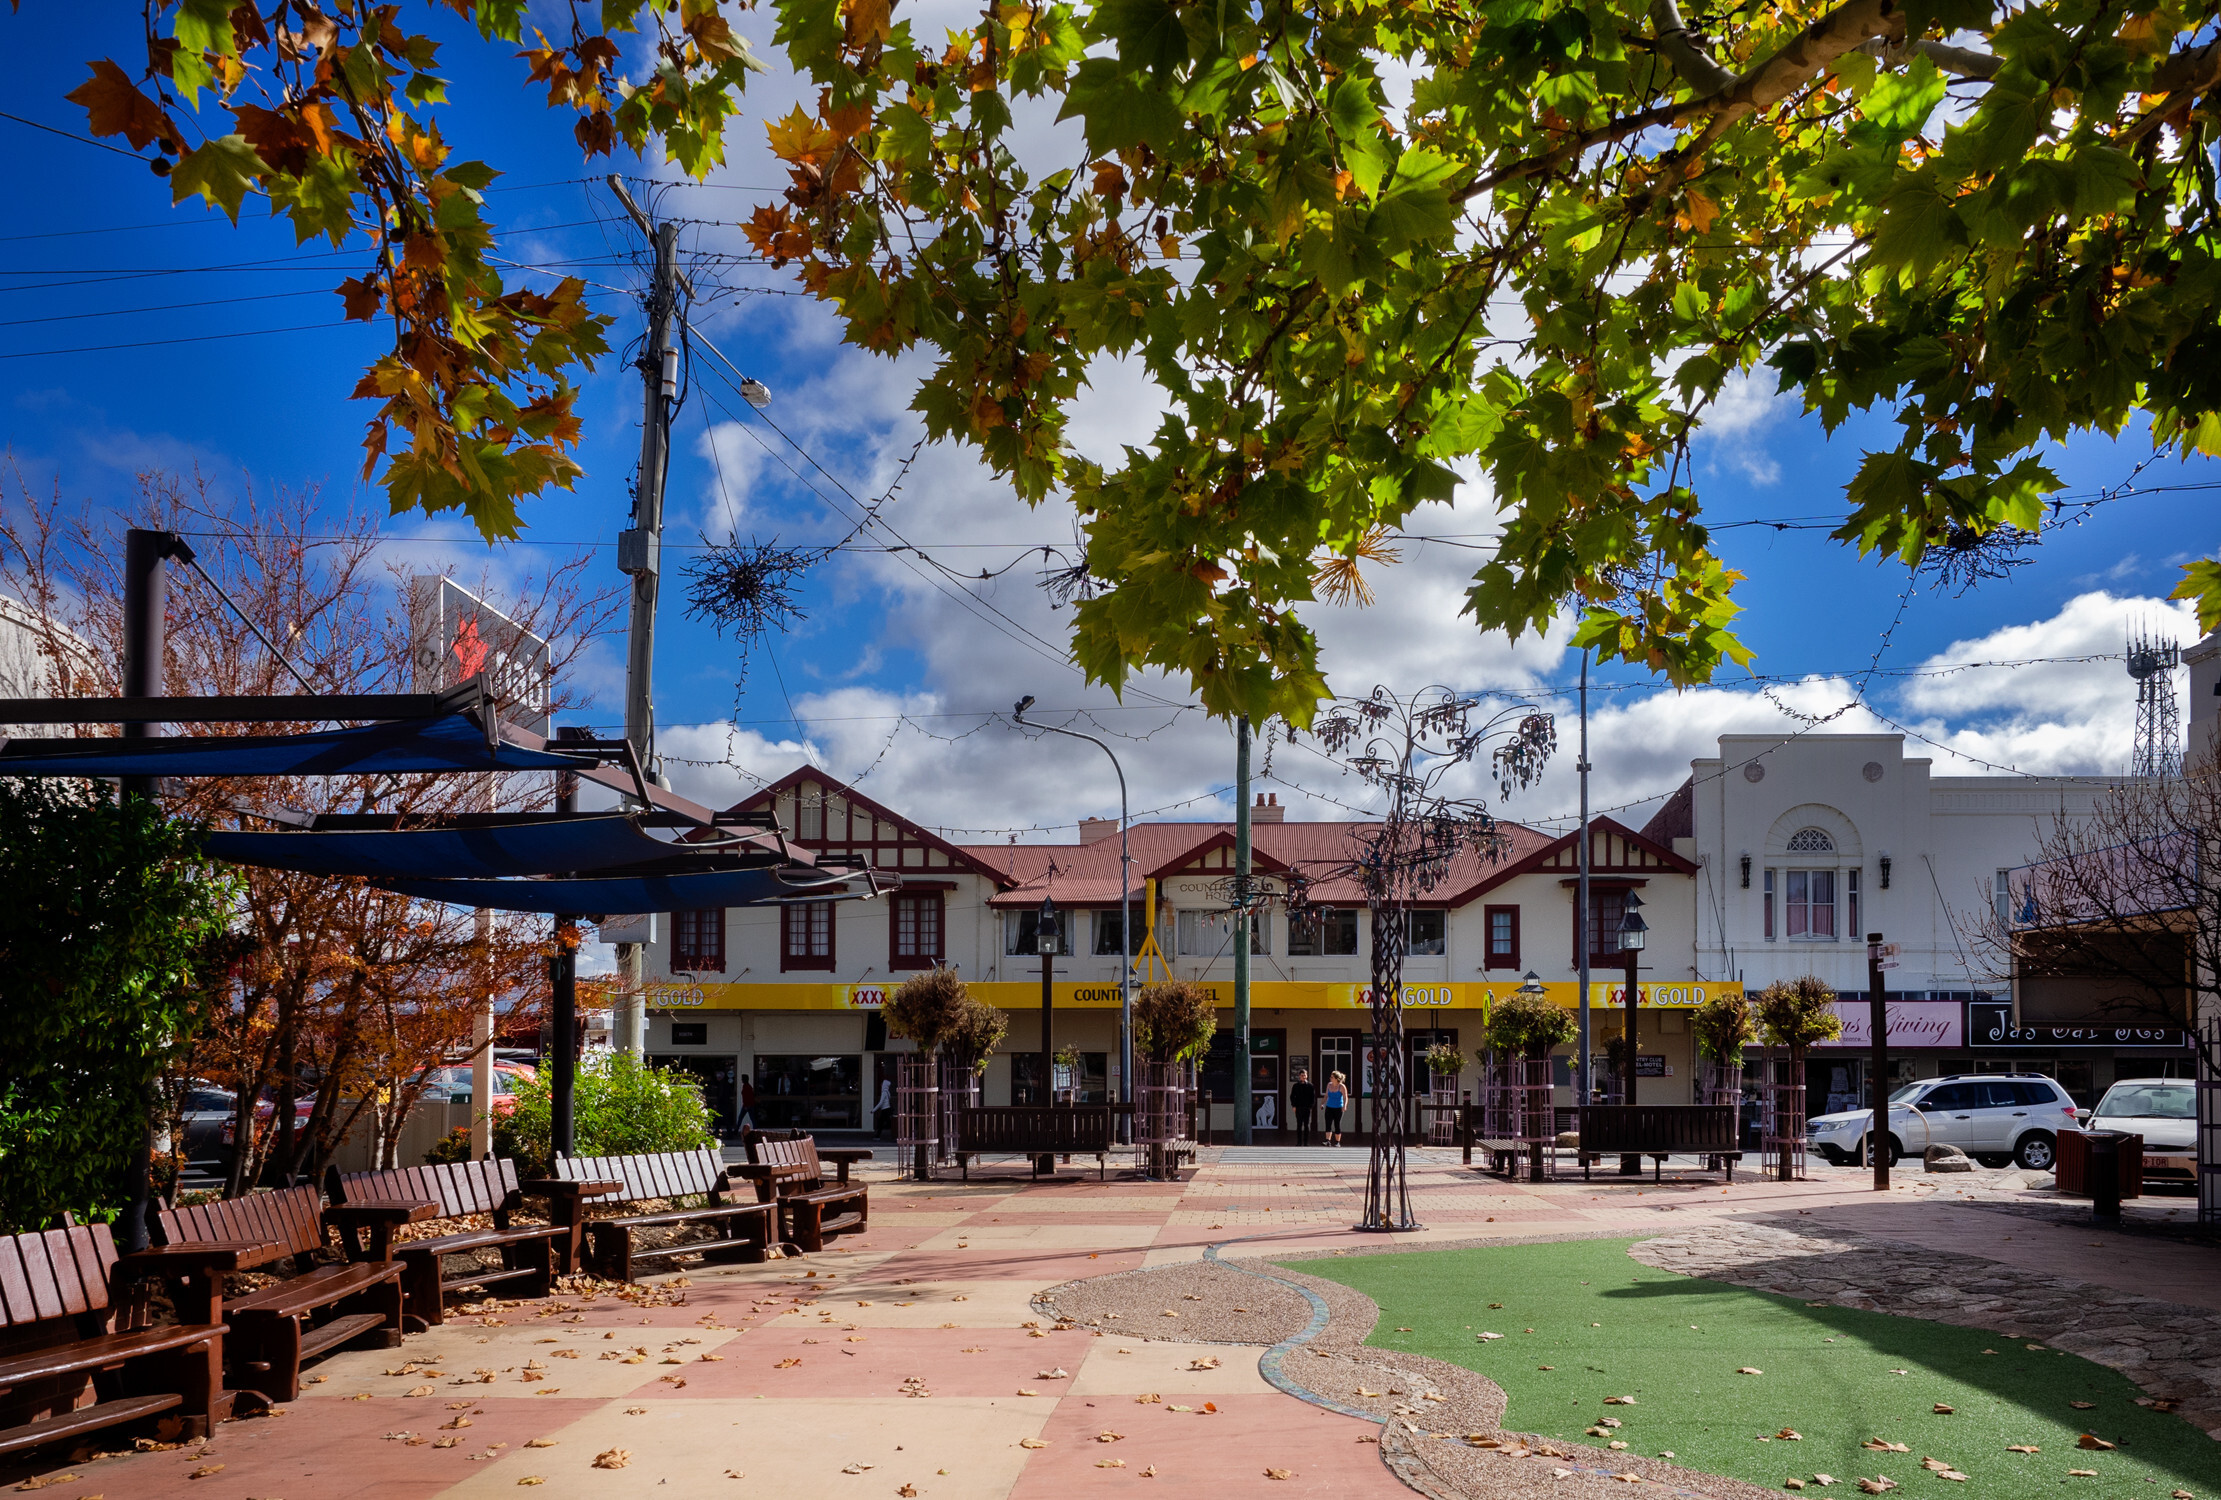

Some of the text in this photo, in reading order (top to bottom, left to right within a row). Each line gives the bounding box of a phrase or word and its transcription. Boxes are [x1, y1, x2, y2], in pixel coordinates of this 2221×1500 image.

[656, 987, 705, 1007] GOLD
[850, 990, 888, 1005] XXXX
[1402, 987, 1453, 1006] GOLD
[1654, 986, 1706, 1006] GOLD
